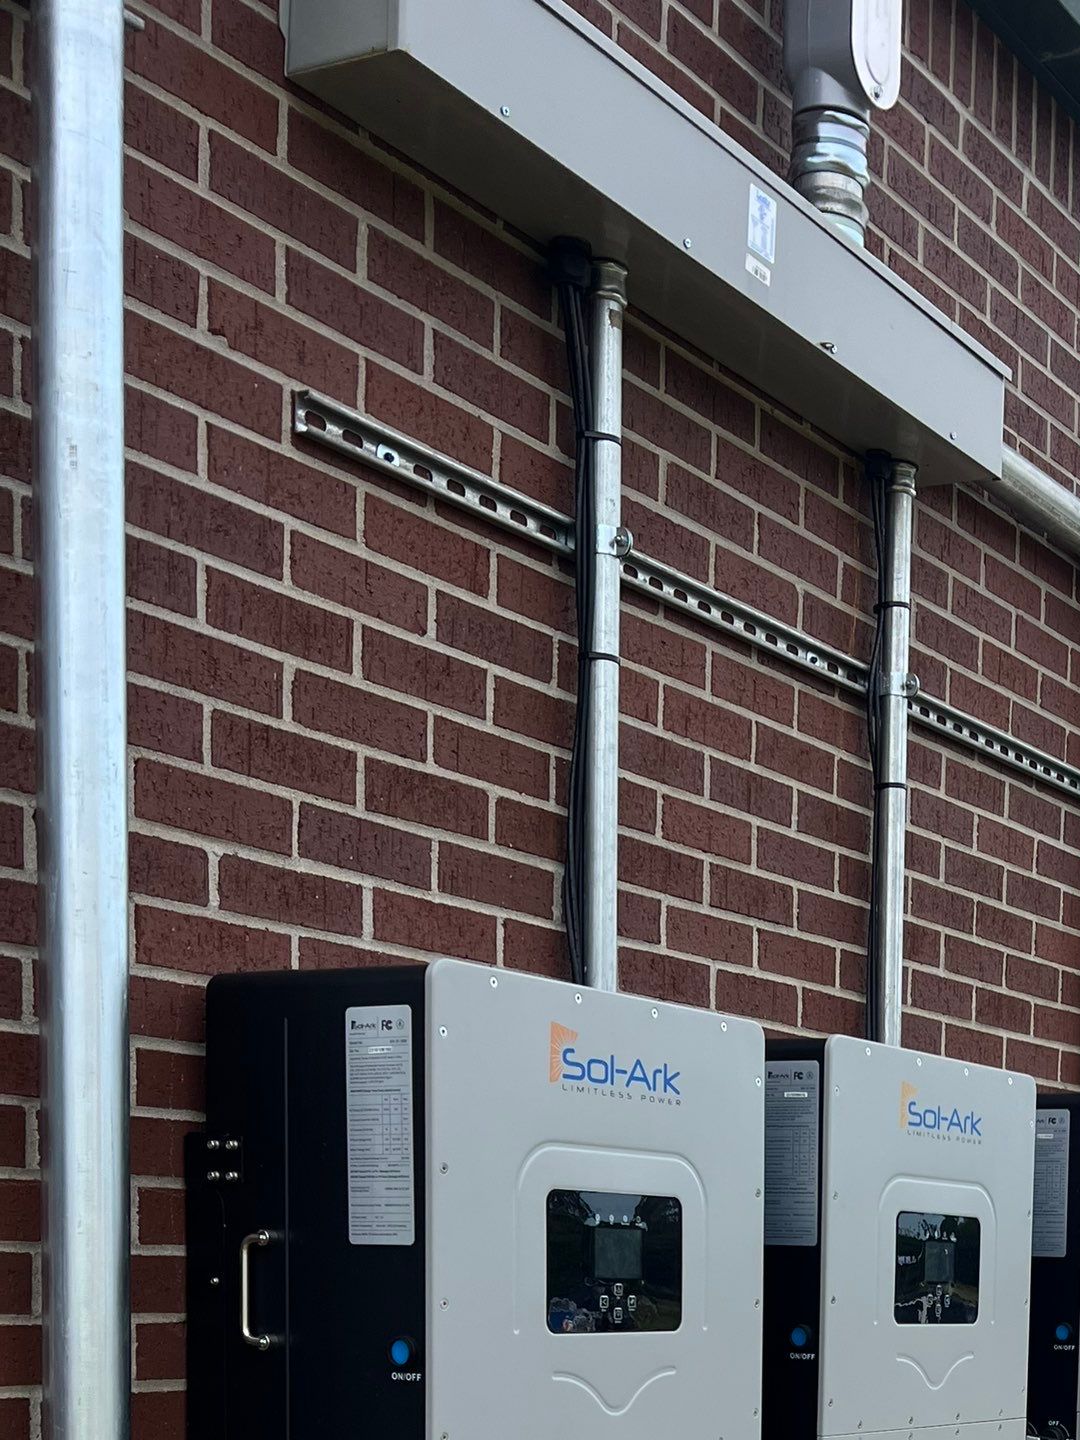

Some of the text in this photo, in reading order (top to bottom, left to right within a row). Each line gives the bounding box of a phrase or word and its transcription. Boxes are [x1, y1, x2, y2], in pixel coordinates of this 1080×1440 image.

[562, 1047, 681, 1096] Sol-Ark
[562, 1083, 682, 1106] LIMITLESS POWER
[908, 1101, 982, 1137] Sol-Ark
[391, 1371, 422, 1381] ON/OFF
